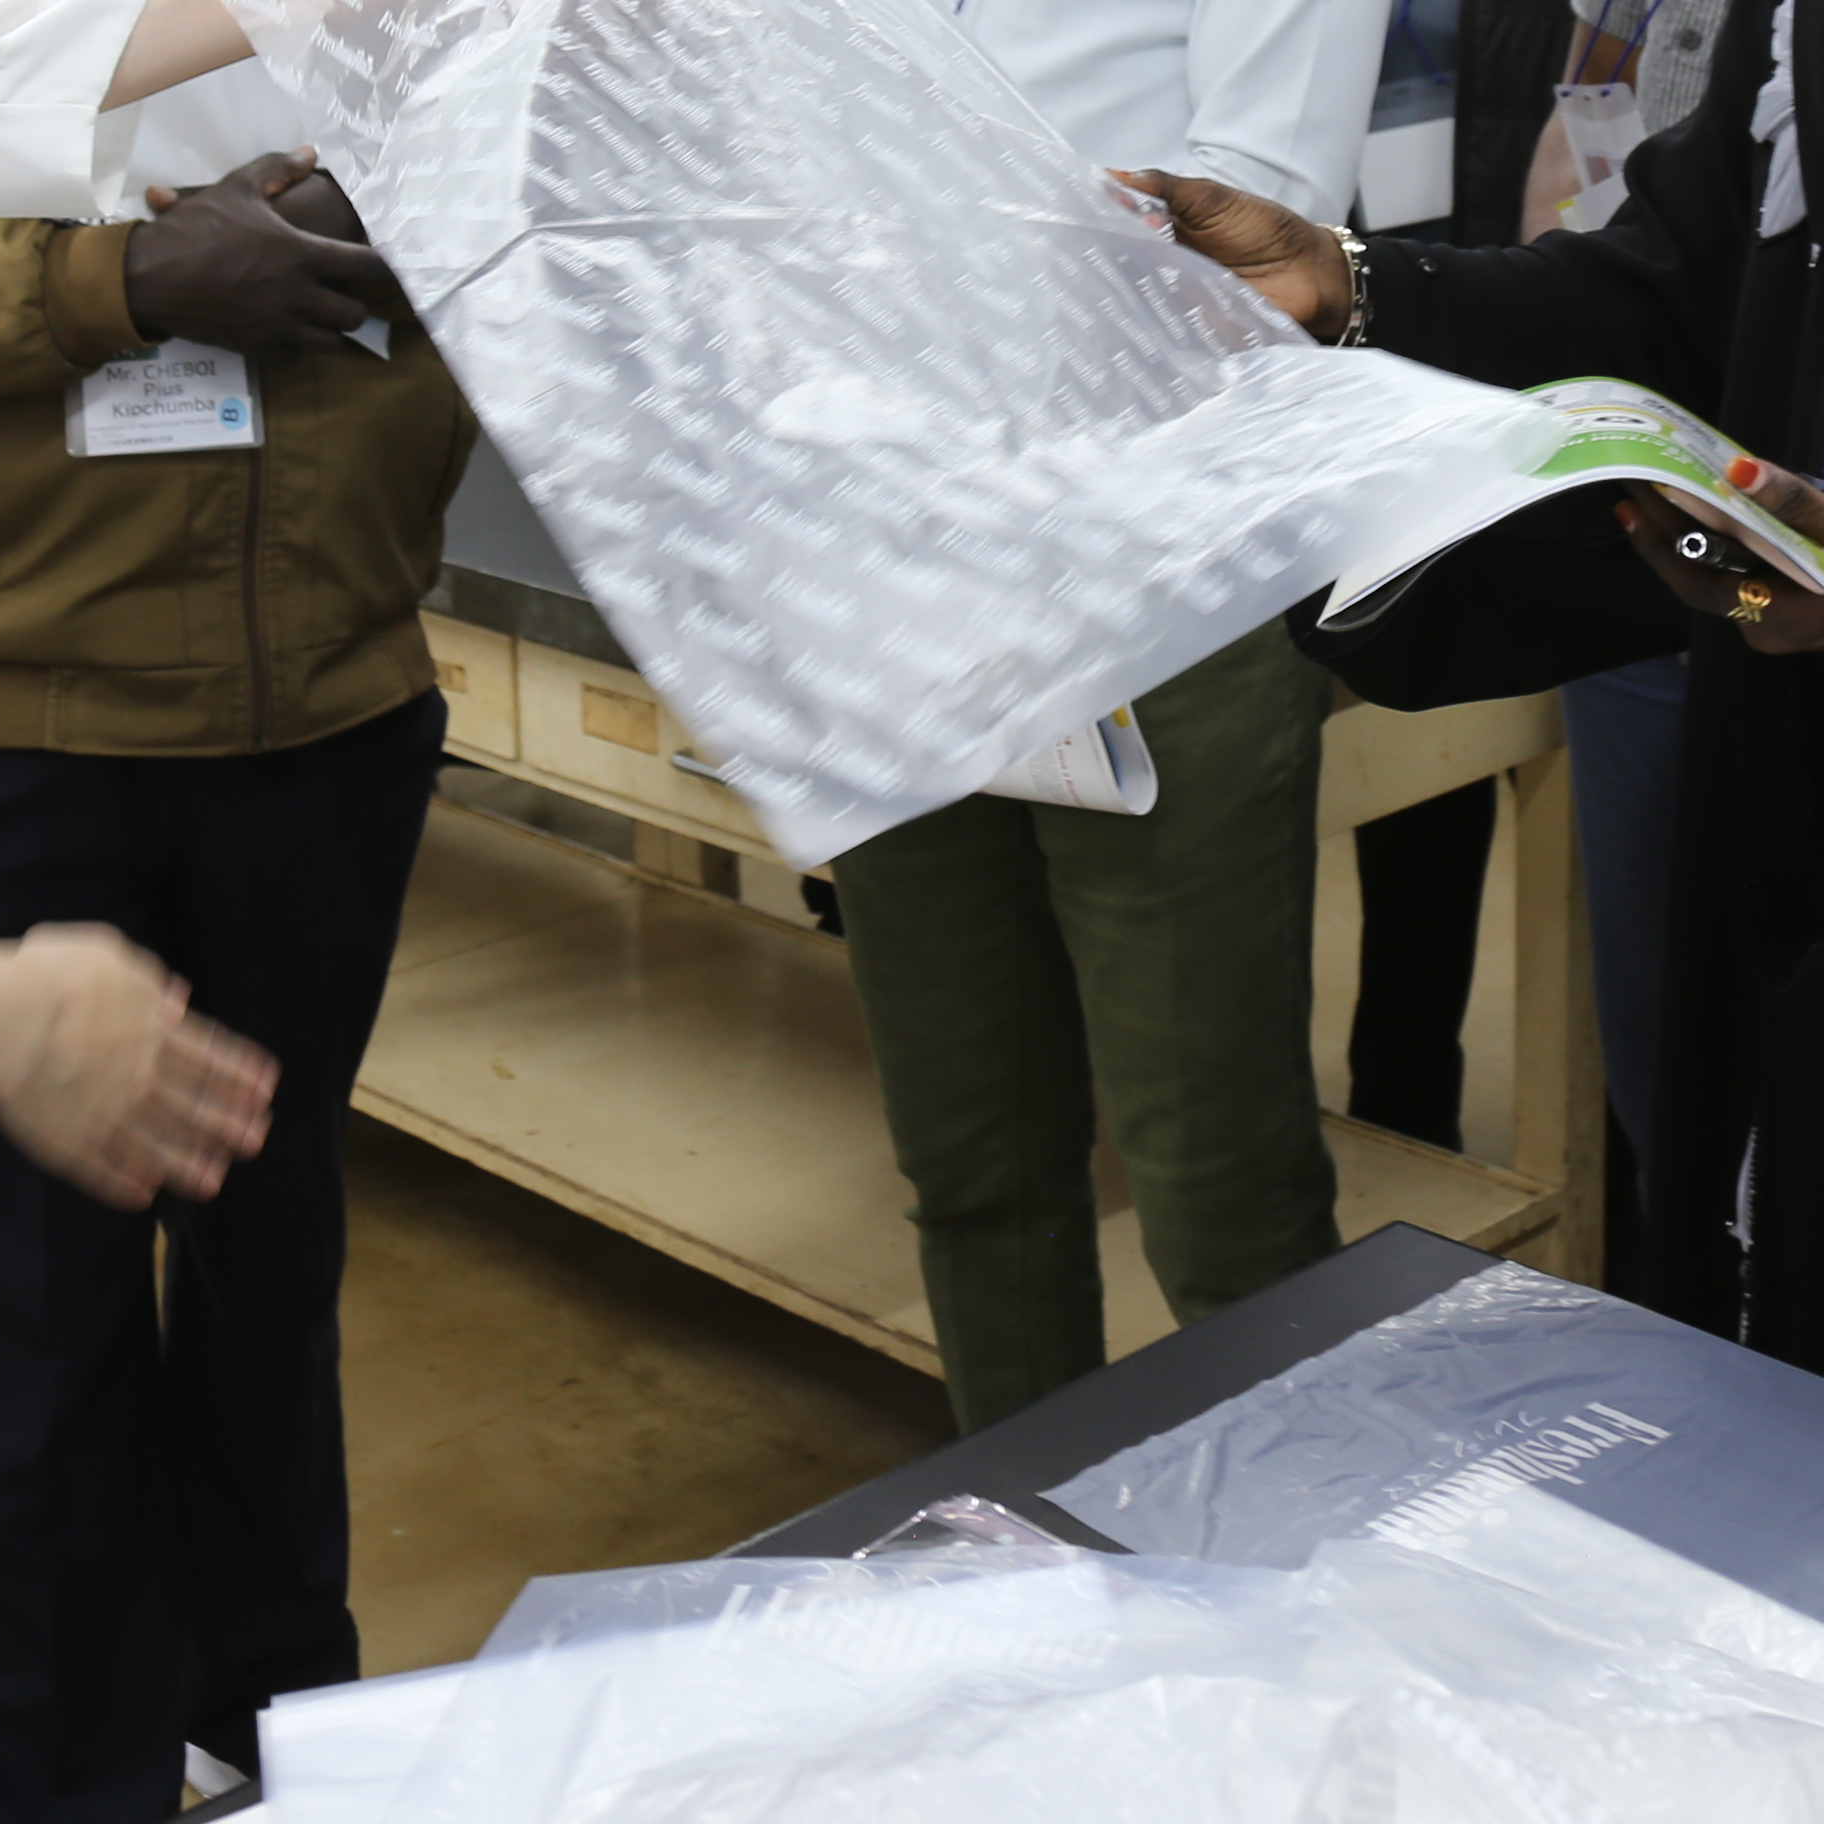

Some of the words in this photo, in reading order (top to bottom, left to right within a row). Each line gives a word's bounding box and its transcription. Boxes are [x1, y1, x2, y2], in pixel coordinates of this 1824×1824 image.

[105, 367, 137, 383] Mr.
[143, 361, 217, 380] CHEBOI
[144, 382, 185, 397] Pius
[112, 397, 217, 418] Kipchumba
[221, 407, 240, 423] B
